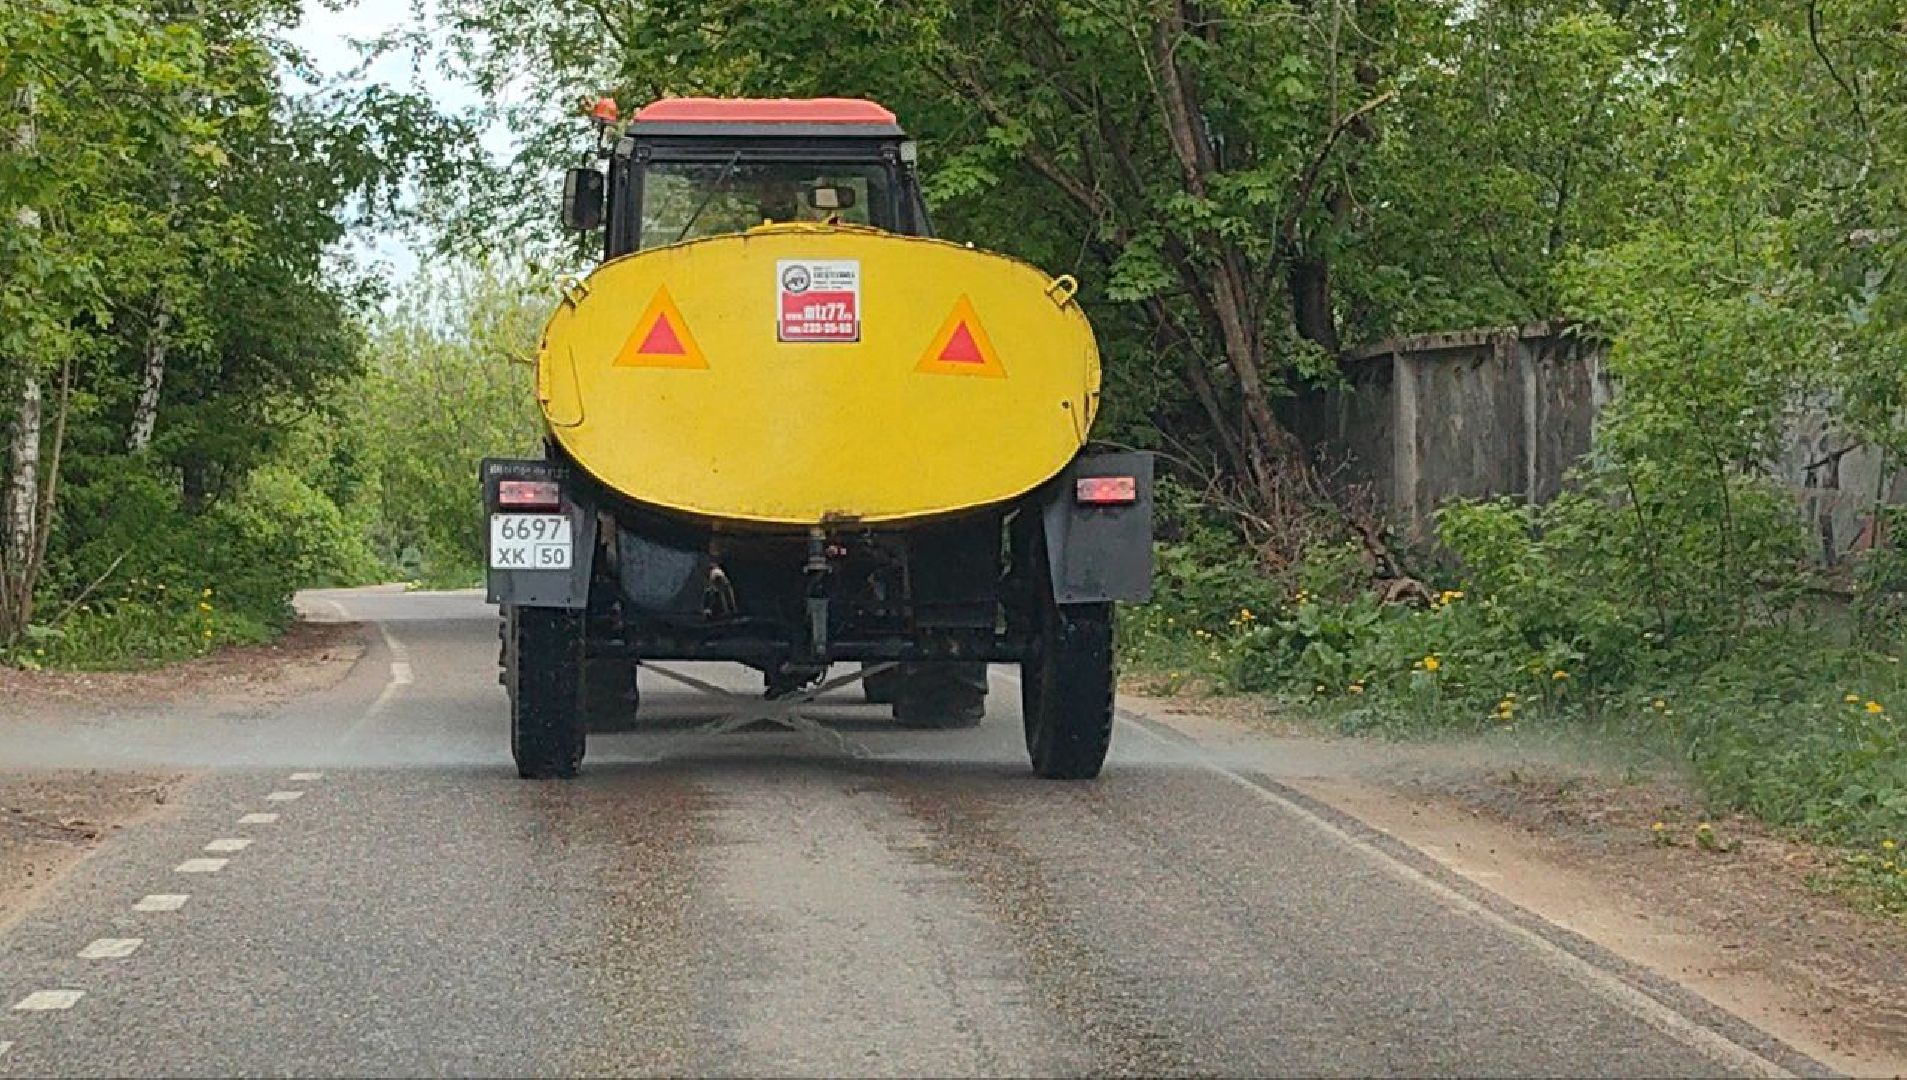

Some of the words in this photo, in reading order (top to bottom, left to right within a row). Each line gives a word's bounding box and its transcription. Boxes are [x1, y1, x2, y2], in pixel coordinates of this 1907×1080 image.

[501, 518, 561, 540] 6697
[498, 547, 526, 564] ХК
[541, 547, 565, 564] 50
